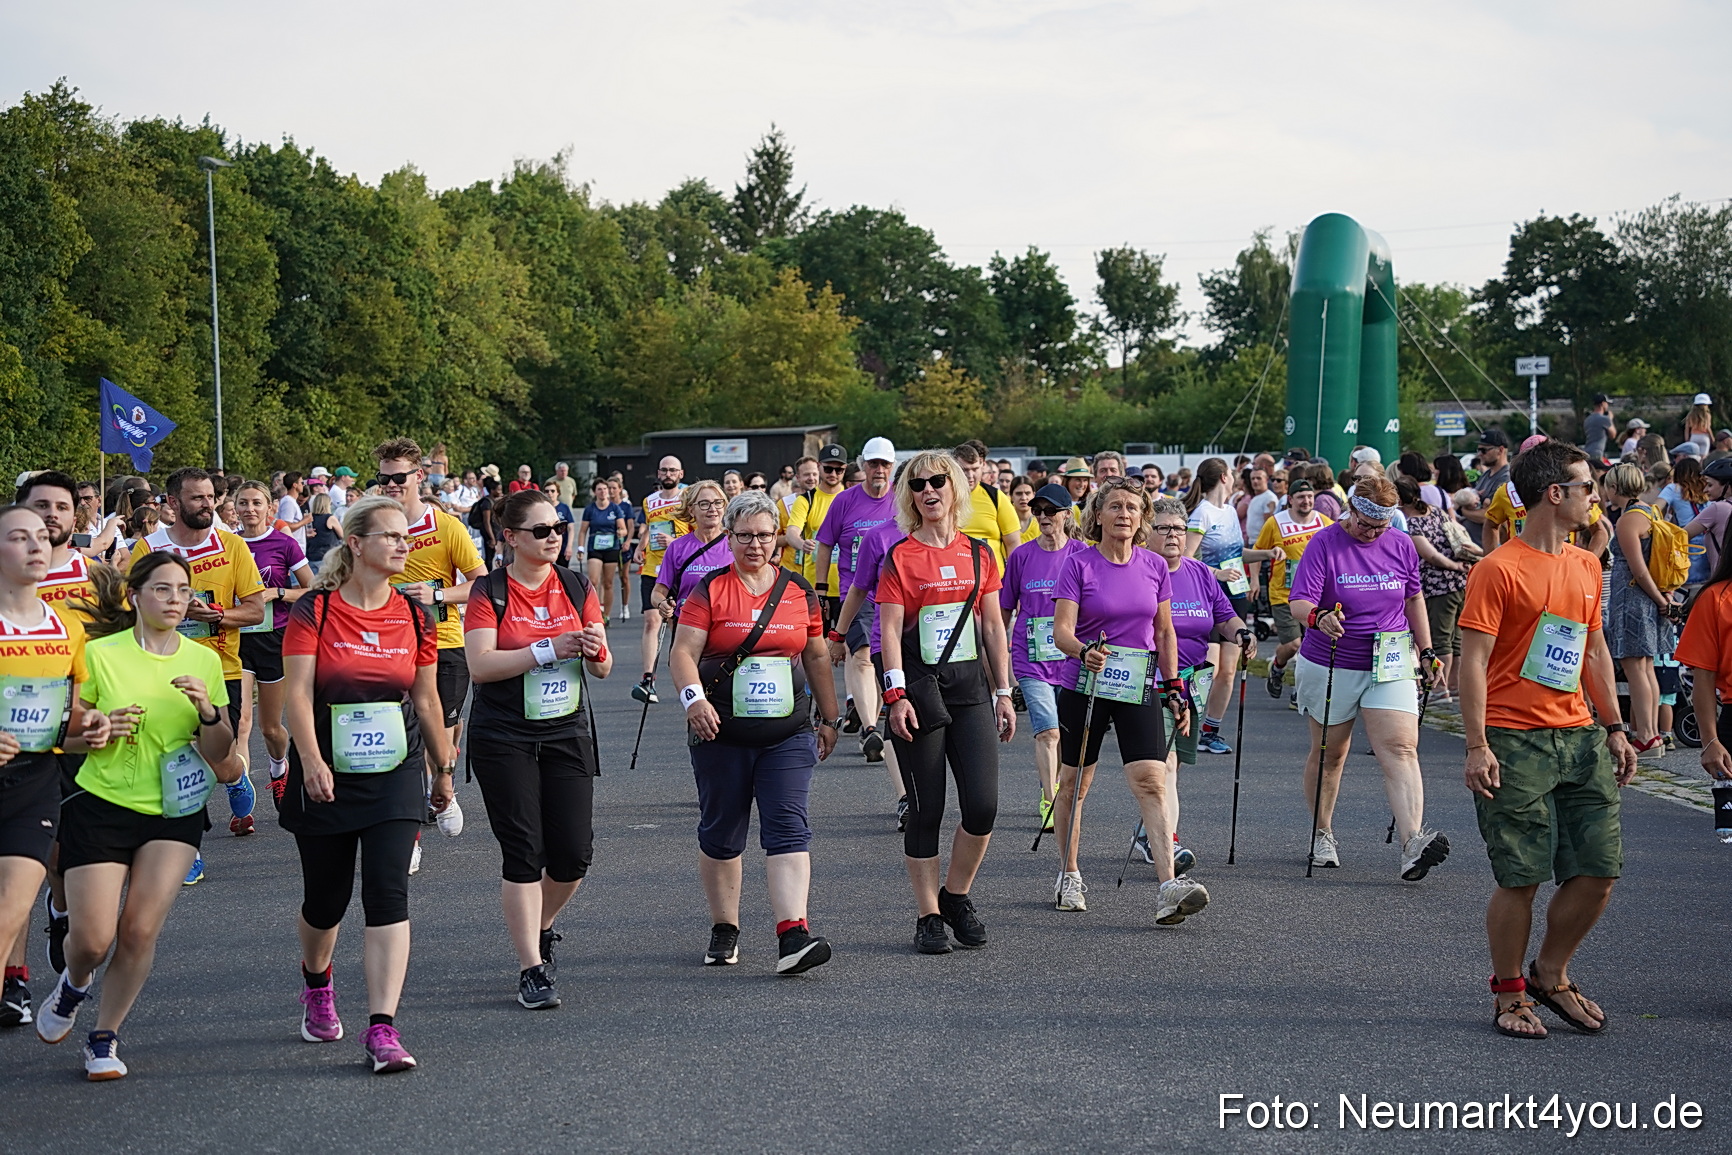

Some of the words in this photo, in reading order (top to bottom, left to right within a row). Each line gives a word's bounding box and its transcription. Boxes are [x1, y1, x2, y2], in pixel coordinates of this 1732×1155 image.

[853, 518, 887, 528] diakon
[1283, 536, 1304, 547] MAX
[192, 557, 230, 575] BÖGL
[685, 564, 720, 572] diakoni
[1026, 578, 1057, 590] diako
[1336, 571, 1390, 584] diakonie
[1380, 579, 1402, 590] nah
[41, 586, 92, 602] BÖGL
[1171, 600, 1197, 610] onie
[1188, 609, 1209, 618] nah
[34, 643, 72, 656] BÖGL
[333, 641, 374, 652] DONHAUSER
[1385, 651, 1400, 663] 695
[1545, 643, 1580, 666] 1063
[1103, 667, 1130, 681] 699
[541, 680, 567, 696] 728
[748, 682, 777, 695] 729
[10, 707, 50, 723] 1847
[351, 732, 386, 747] 732
[176, 769, 206, 791] 1222
